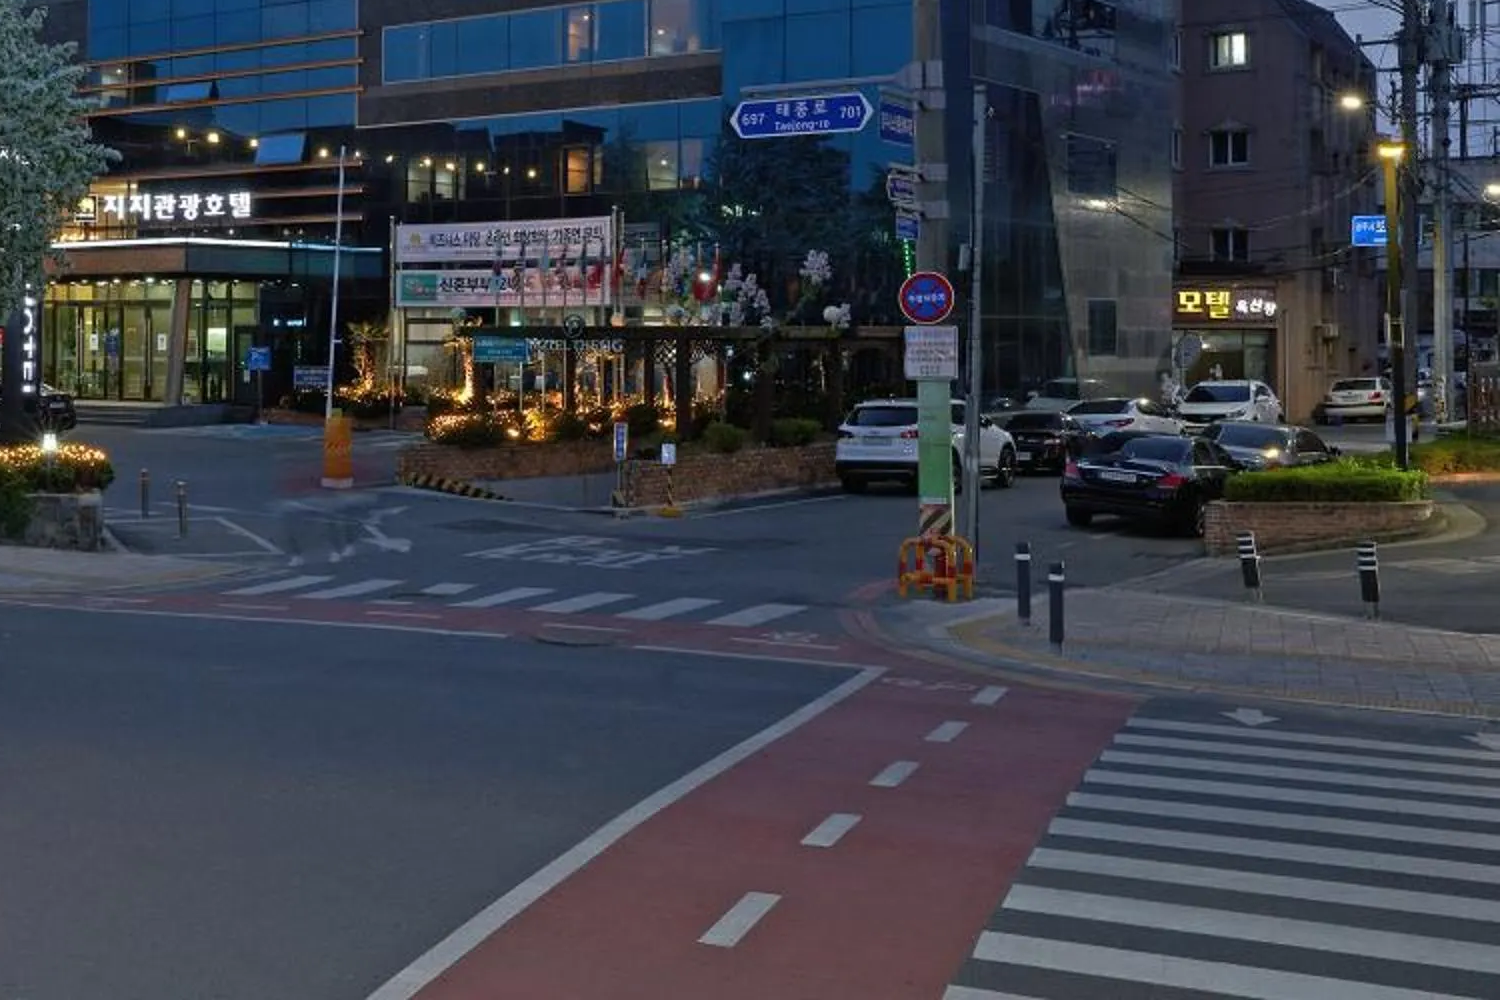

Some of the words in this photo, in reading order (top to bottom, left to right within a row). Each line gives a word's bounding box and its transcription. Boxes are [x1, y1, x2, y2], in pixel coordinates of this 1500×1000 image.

[741, 113, 765, 127] 697
[775, 99, 829, 119] 태종로
[839, 105, 862, 120] 701
[103, 191, 252, 221] 지지관광호텔
[1177, 290, 1231, 319] 모텔
